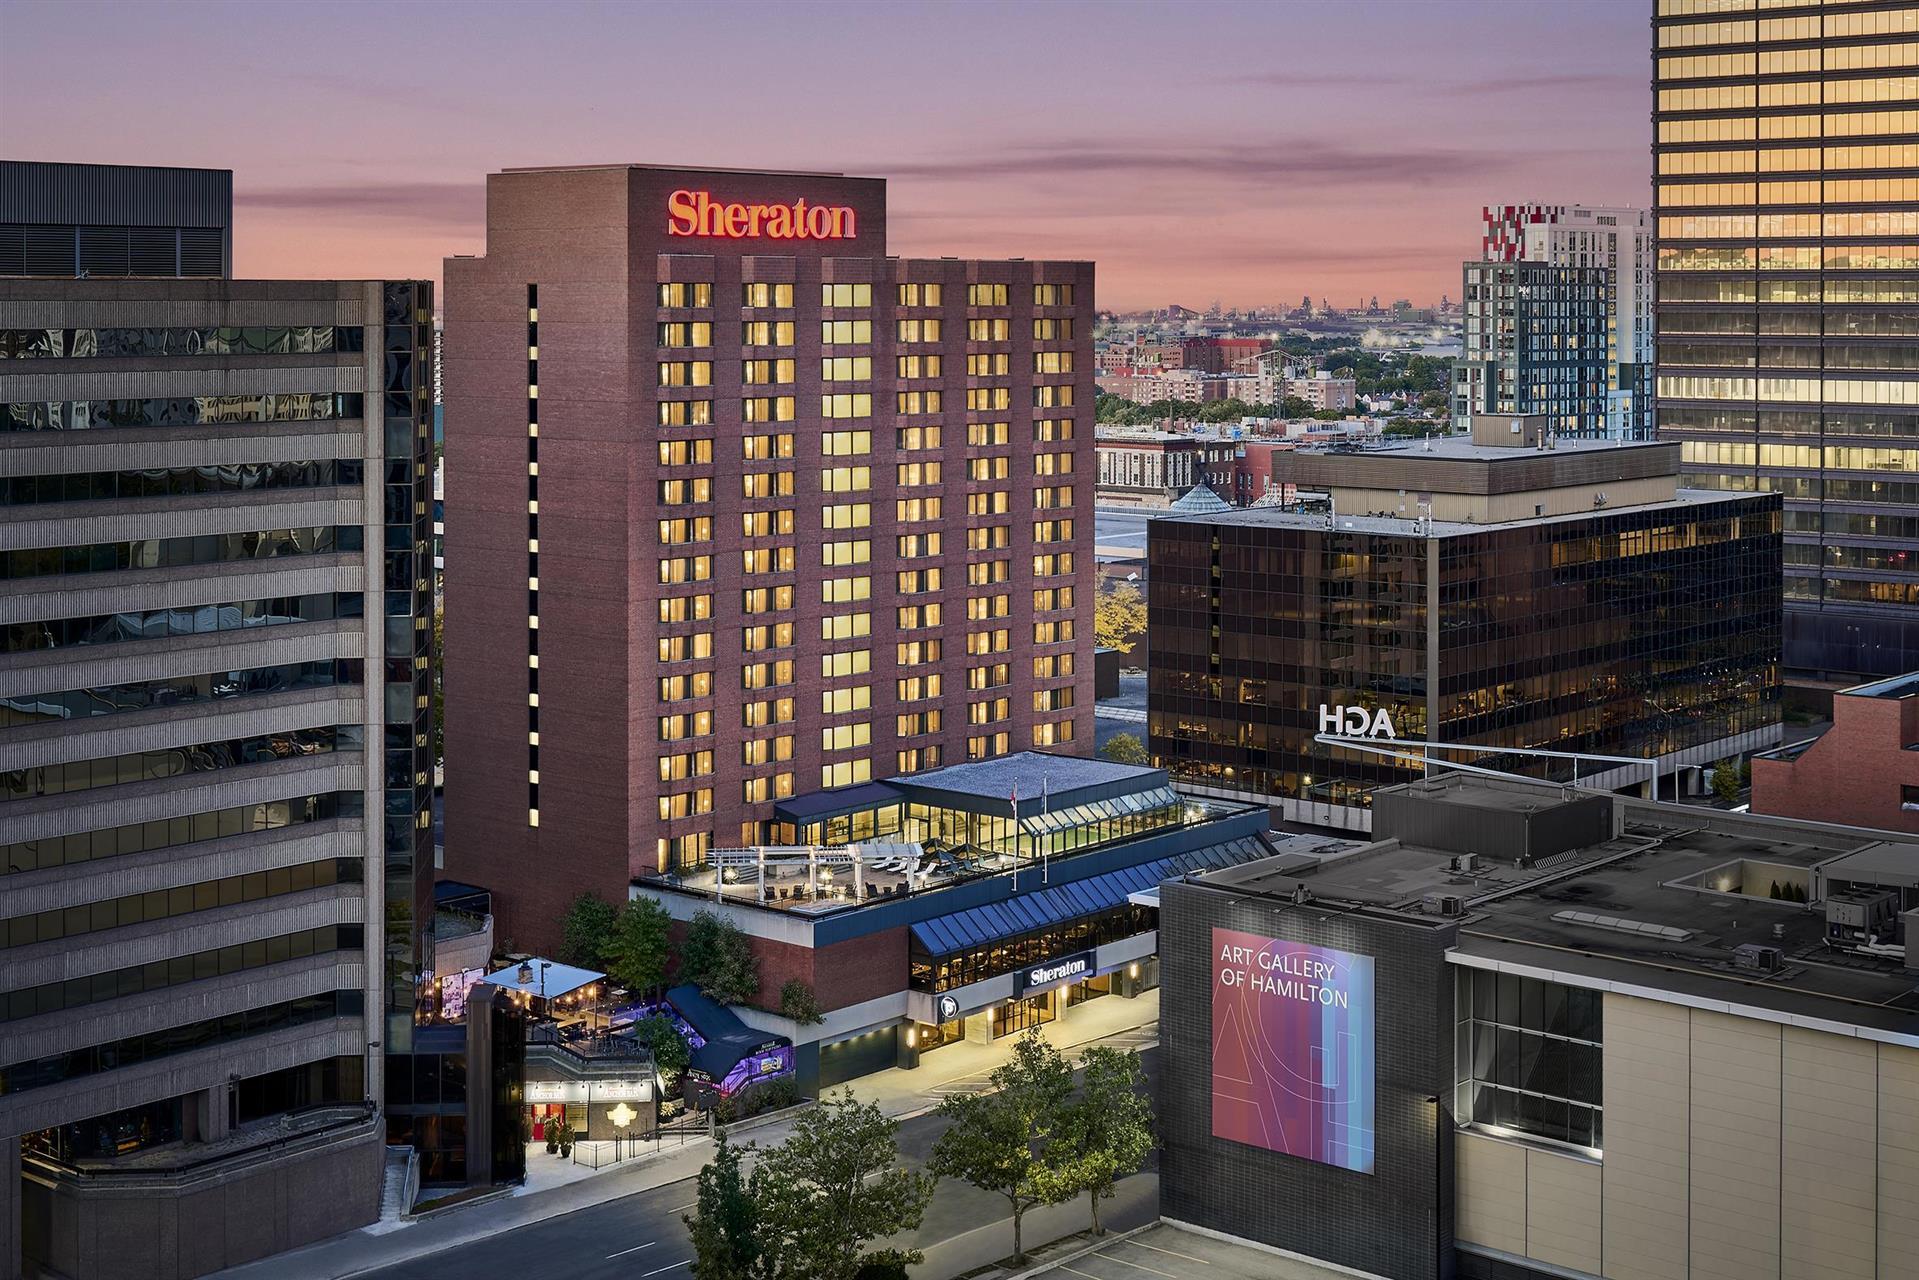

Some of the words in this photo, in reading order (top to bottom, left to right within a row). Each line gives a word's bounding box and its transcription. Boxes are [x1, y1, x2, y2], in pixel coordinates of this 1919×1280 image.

[668, 190, 857, 239] Sheraton
[1031, 960, 1086, 986] Sheraton
[1220, 944, 1254, 966] ART
[1258, 952, 1335, 981] GALLERY
[1221, 968, 1245, 988] OF
[1251, 973, 1348, 1009] HAMILTON
